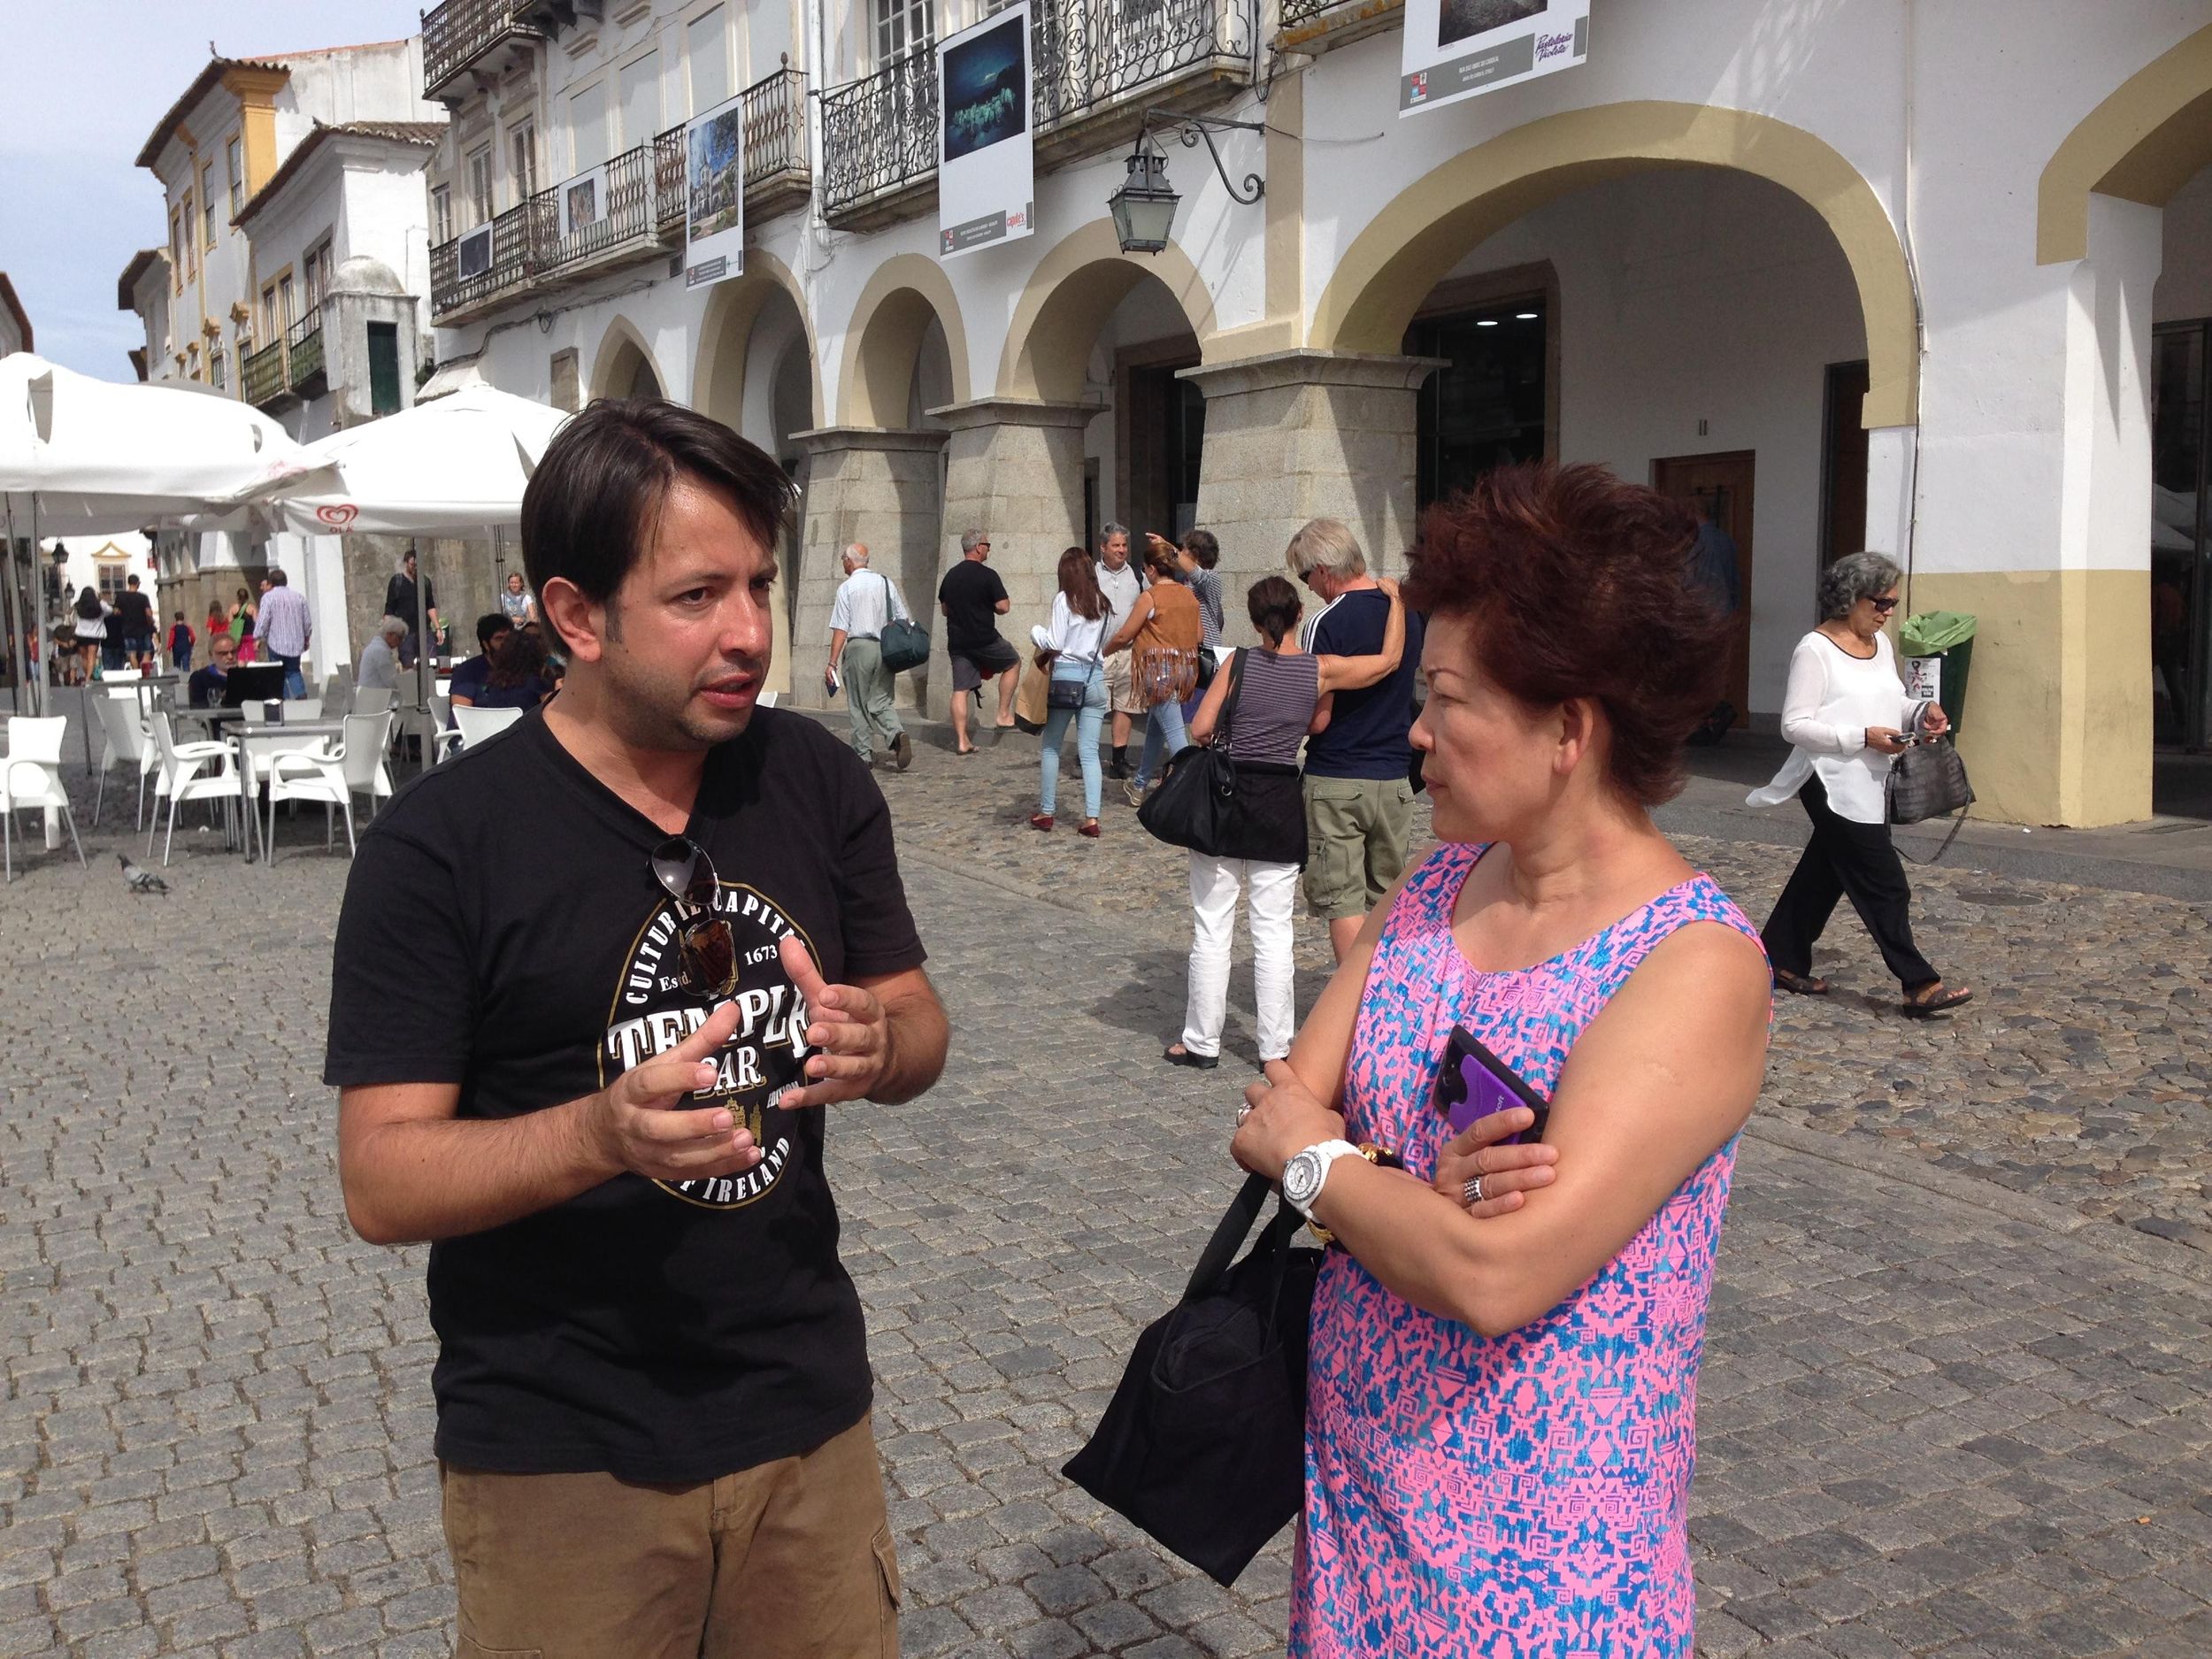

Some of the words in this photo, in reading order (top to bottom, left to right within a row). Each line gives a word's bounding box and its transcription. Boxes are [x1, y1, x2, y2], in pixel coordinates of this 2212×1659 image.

[712, 891, 805, 948] CAPIT
[744, 944, 778, 966] 1673
[703, 1137, 790, 1202] IRELAND
